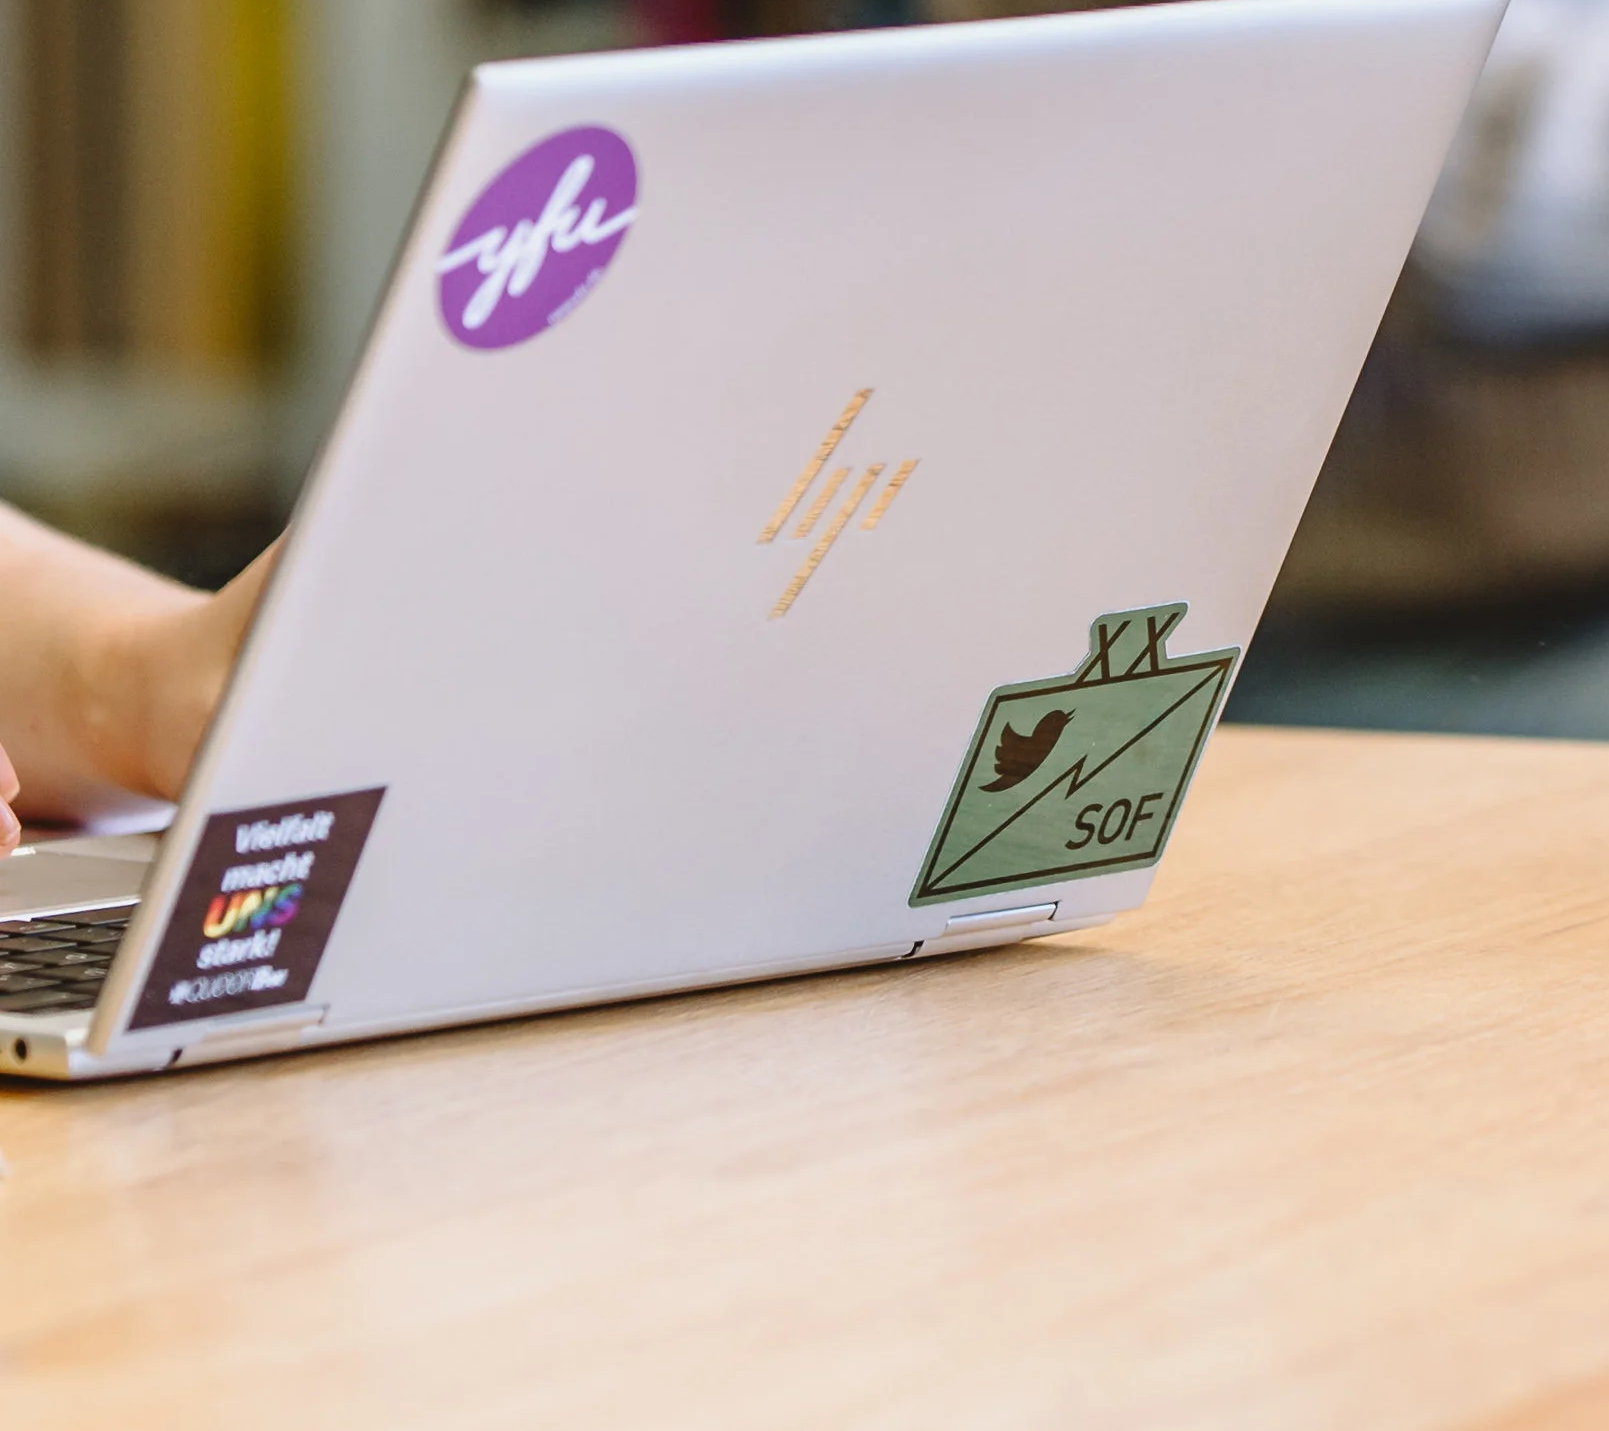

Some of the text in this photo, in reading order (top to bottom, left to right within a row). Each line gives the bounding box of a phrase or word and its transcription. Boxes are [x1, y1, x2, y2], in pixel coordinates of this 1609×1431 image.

[236, 810, 335, 854] Vielfalt
[1065, 793, 1163, 850] SOF
[221, 851, 316, 892] macht
[203, 884, 305, 938] UNS
[196, 928, 282, 970] stark!
